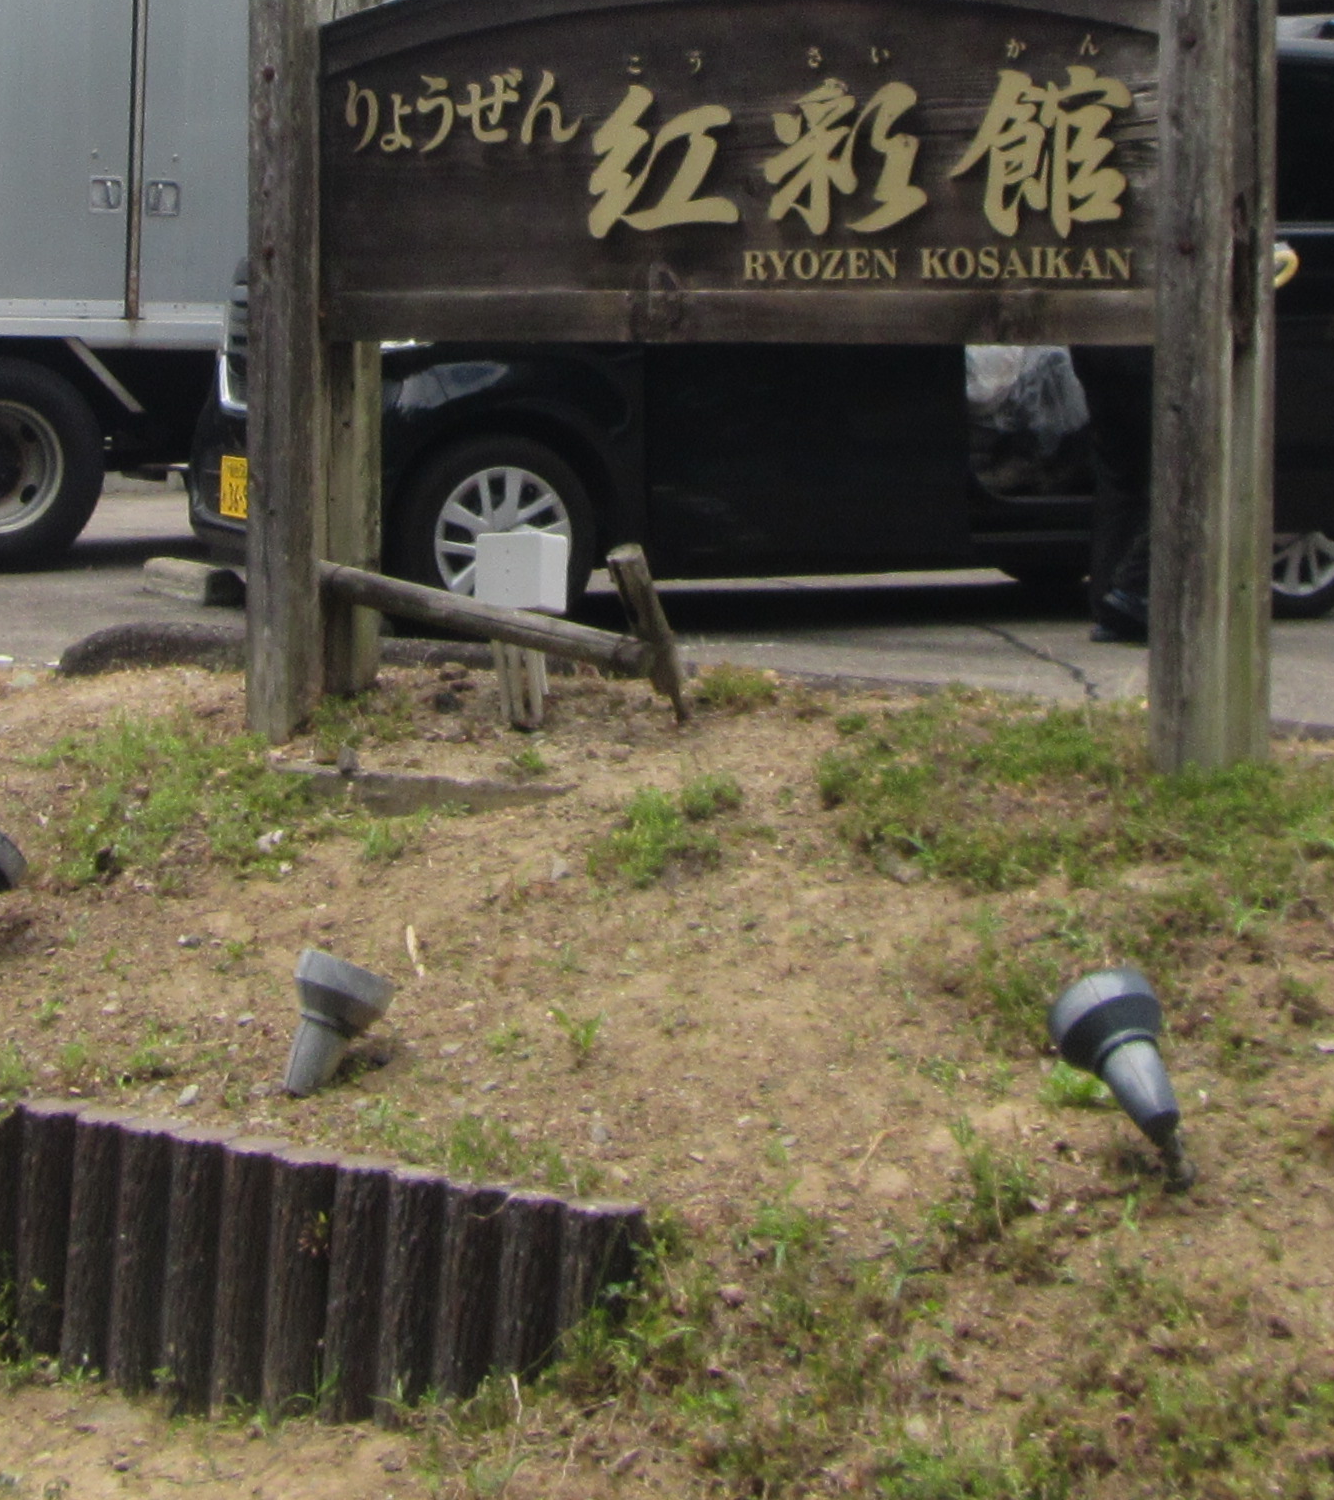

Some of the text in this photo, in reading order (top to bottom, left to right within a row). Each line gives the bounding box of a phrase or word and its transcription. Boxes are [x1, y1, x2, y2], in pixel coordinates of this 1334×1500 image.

[345, 65, 1132, 239] りょうぜん 紅彩館
[743, 246, 1133, 280] RYOZEN KOSAIKAN
